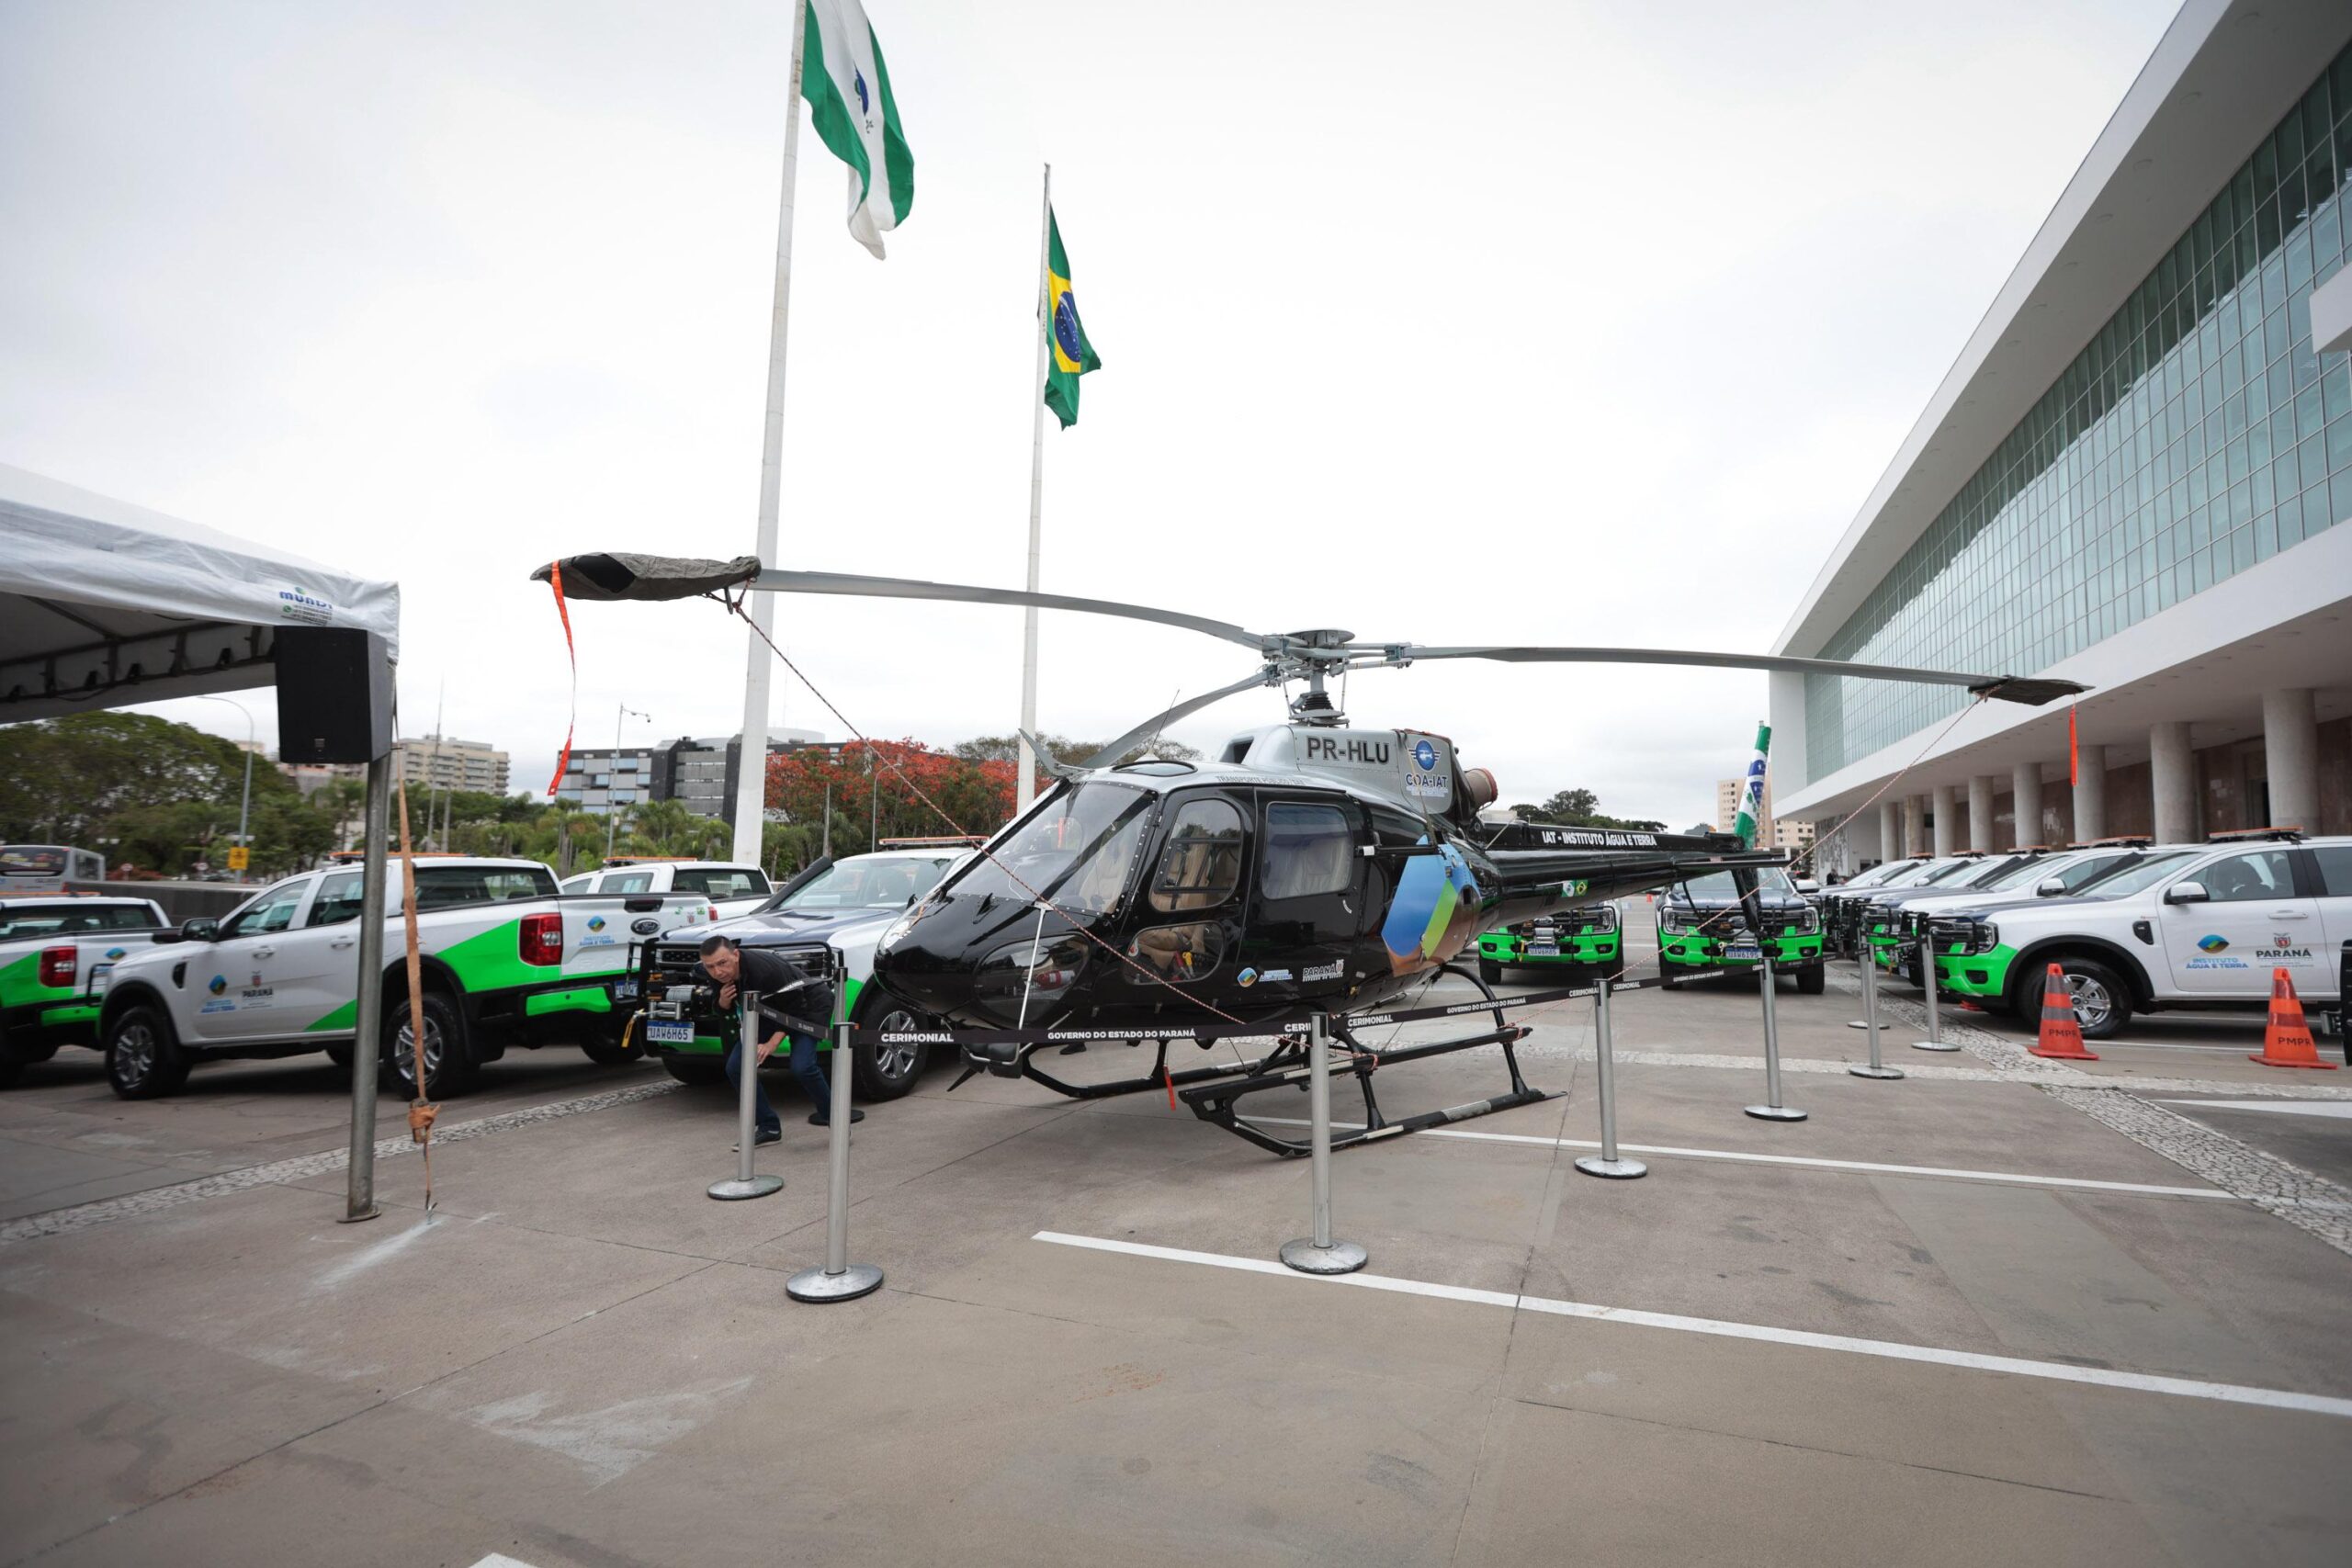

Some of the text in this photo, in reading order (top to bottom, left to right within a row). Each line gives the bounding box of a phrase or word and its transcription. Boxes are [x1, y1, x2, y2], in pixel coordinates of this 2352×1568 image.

[1306, 737, 1389, 764] PR-HLU
[1406, 773, 1448, 788] COA-IAT
[1542, 830, 1556, 844] IAT
[1562, 832, 1605, 846] INSTITUTO
[1605, 831, 1627, 846] ÁGUA
[1627, 835, 1633, 845] E
[1632, 835, 1657, 846] TERRA
[2256, 948, 2312, 958] PARANÁ
[1447, 1005, 1471, 1013] GOVERNO
[1507, 997, 1526, 1005] PARANÁ
[1348, 1014, 1393, 1027] CERIMONIAL
[881, 1033, 954, 1042] CERIMONIAL
[1047, 1032, 1091, 1040] GOVERNO
[1144, 1030, 1158, 1038] DO
[1159, 1028, 1196, 1037] PARANÁ
[2278, 1036, 2312, 1045] PMPR
